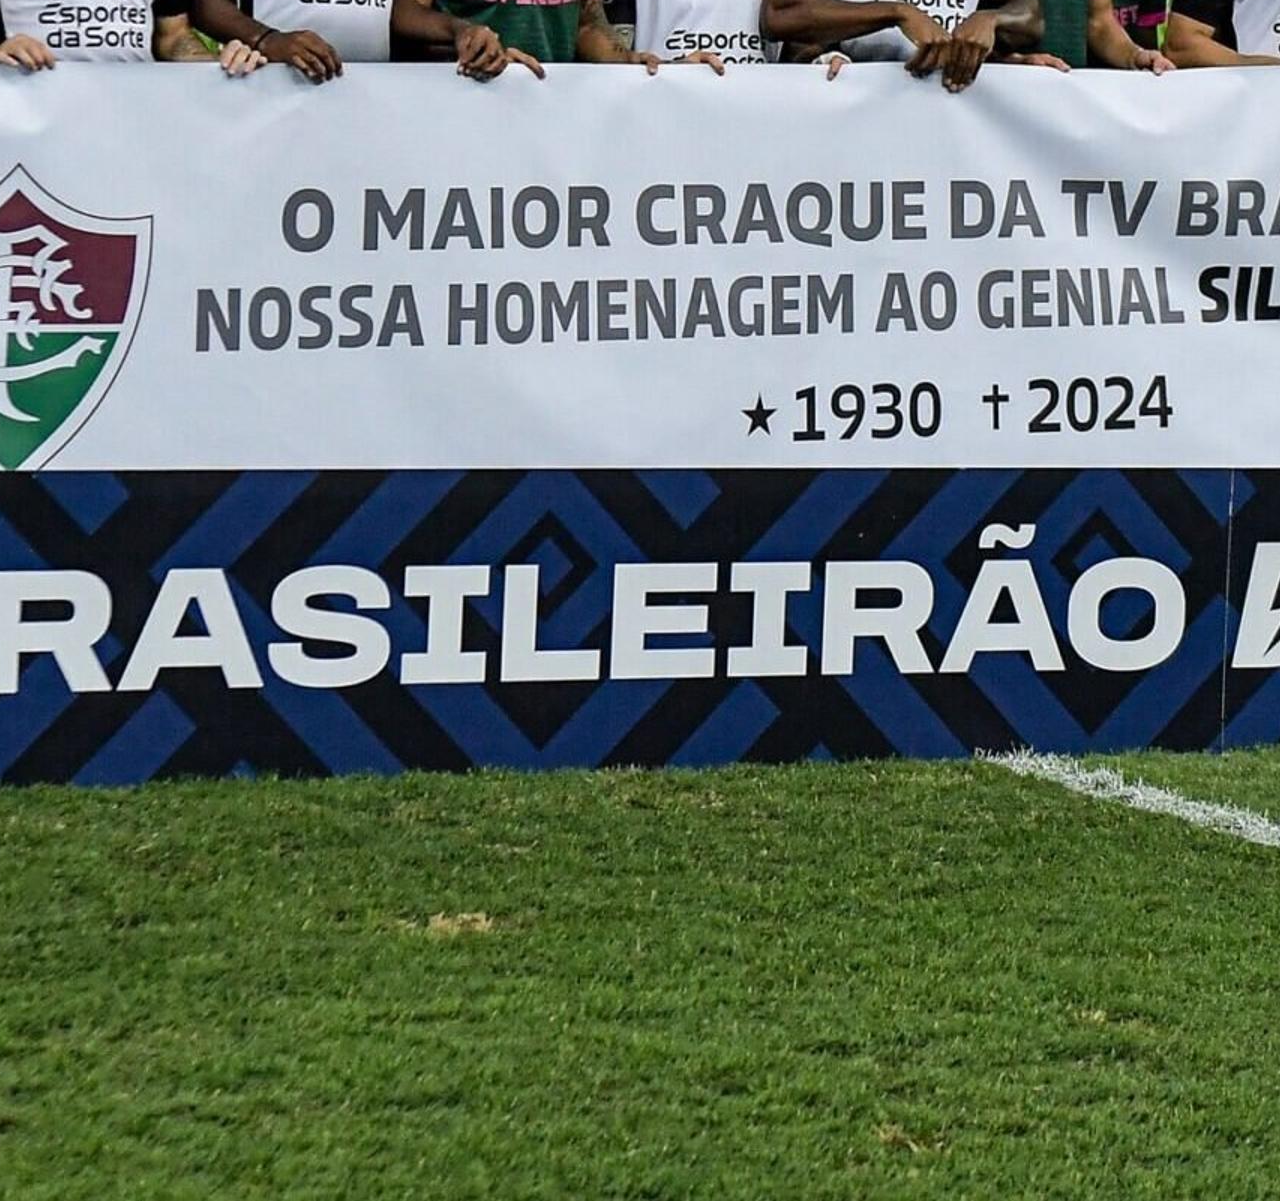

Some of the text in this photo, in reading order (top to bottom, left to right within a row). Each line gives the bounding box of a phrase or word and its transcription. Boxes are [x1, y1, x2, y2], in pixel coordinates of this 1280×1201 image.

[38, 3, 146, 26] Esportes
[46, 27, 144, 49] da Sorte
[665, 29, 761, 51] Esporte
[281, 188, 335, 253] O
[362, 185, 611, 251] MAIOR
[635, 180, 928, 248] CRAQUE
[949, 180, 1045, 239] DA
[1061, 180, 1158, 238] TV
[194, 284, 425, 353] NOSSA
[446, 272, 855, 346] HOMENAGEM
[874, 270, 959, 333] AO
[977, 266, 1186, 330] GENIAL
[791, 380, 943, 443] 1930
[1026, 375, 1174, 434] 2024
